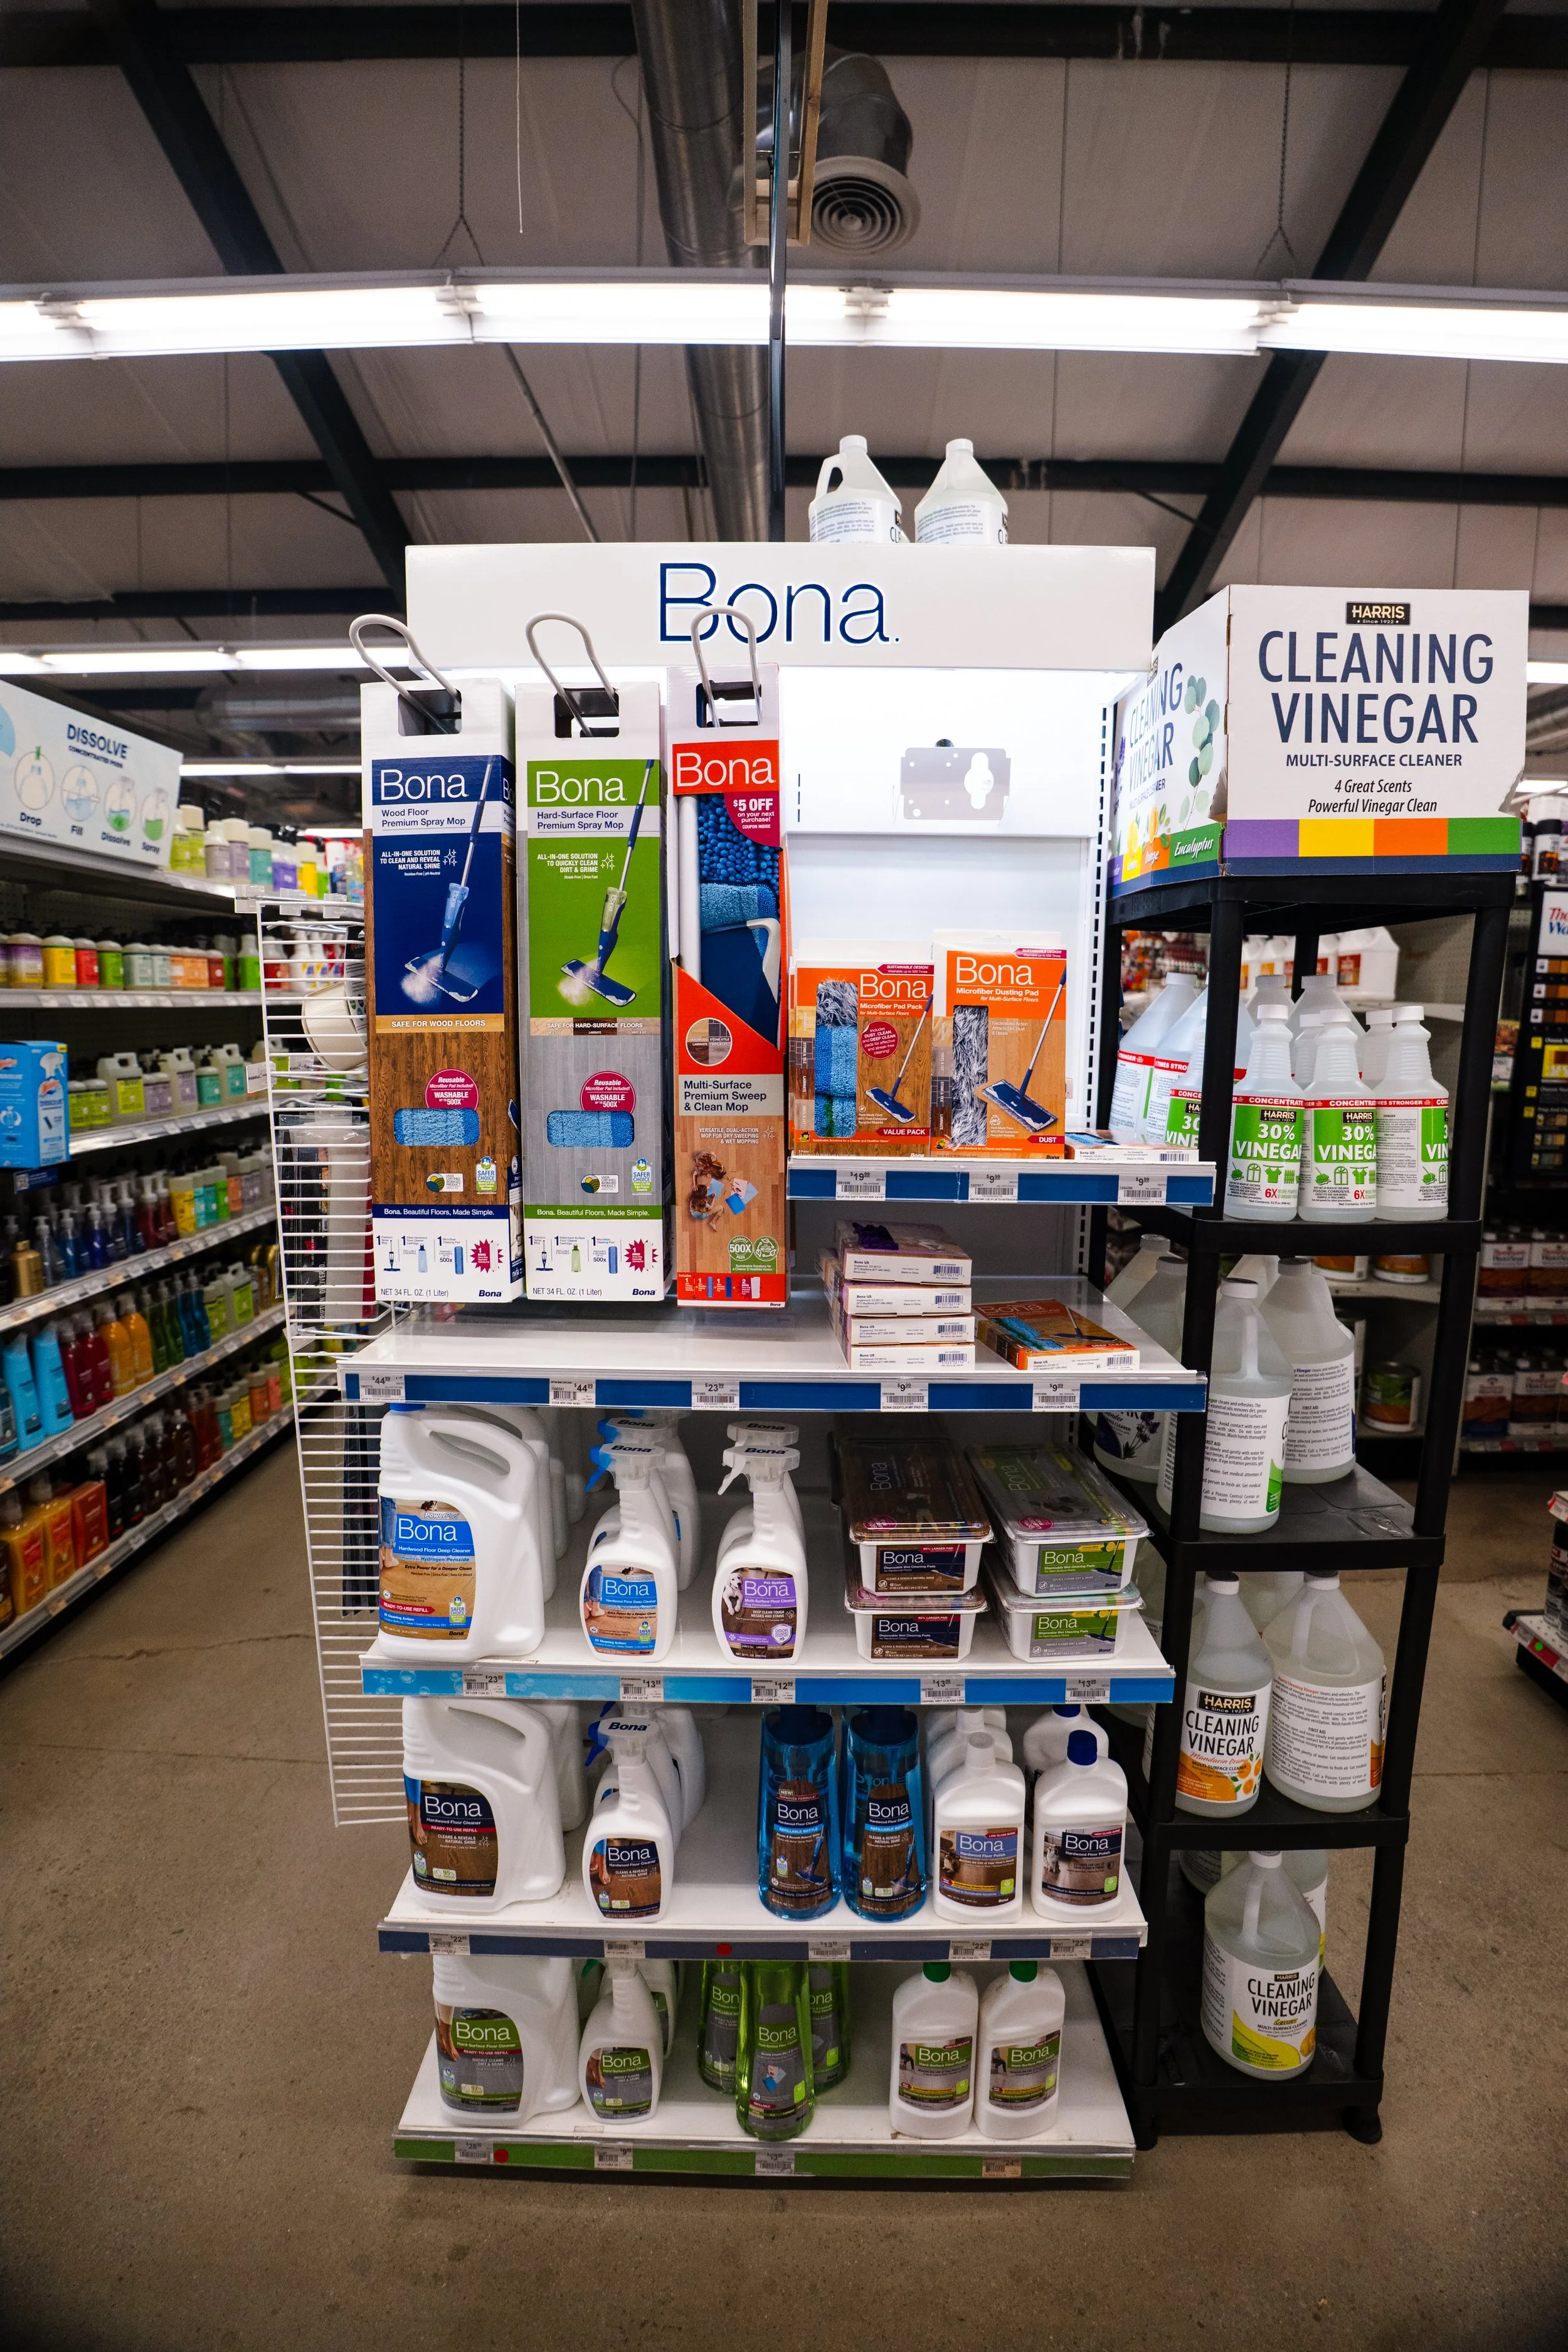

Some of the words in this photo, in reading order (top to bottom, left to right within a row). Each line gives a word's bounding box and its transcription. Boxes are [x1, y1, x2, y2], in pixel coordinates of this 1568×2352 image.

[1352, 606, 1405, 619] HARRIS
[1259, 631, 1493, 684] CLEANING
[1130, 662, 1183, 748] CLEANING
[1271, 692, 1478, 743] VINEGAR
[67, 724, 127, 759] DISSOLVE
[1130, 722, 1173, 793] VINEGAR
[1286, 755, 1396, 767] MULTI-SURFACE
[1399, 755, 1462, 766] CLEANER
[677, 753, 774, 787] Bona
[381, 769, 467, 800] Bona
[536, 771, 625, 802] Bona
[1335, 780, 1341, 793] 4
[1345, 780, 1374, 793] Great
[1377, 780, 1412, 793] Scents
[733, 800, 746, 812] $5
[749, 798, 773, 811] OFF
[1308, 799, 1359, 813] Powerful
[1362, 799, 1404, 815] Vinegar
[1407, 798, 1437, 812] Clean
[20, 812, 41, 826] Drop
[421, 818, 444, 827] Spray
[578, 822, 602, 830] Spray
[605, 822, 623, 830] Mop
[71, 825, 83, 835] Fill
[102, 832, 130, 846] Dissolve
[142, 842, 159, 854] Spray
[1174, 838, 1214, 858] Eucalyptus
[956, 957, 1033, 985] Bona
[860, 974, 928, 999] Bona
[995, 988, 1023, 997] Dusting
[684, 1080, 751, 1089] Multi-Surface
[684, 1091, 729, 1100] Premium
[732, 1091, 766, 1101] Sweep
[1249, 1097, 1303, 1106] CONCENTRATE
[684, 1103, 691, 1111] &
[694, 1103, 723, 1111] Clean
[726, 1103, 748, 1112] Mop
[1264, 1111, 1295, 1120] HARRIS
[1258, 1124, 1295, 1141] 30%
[1342, 1126, 1374, 1141] 30%
[1265, 1189, 1278, 1199] 6X
[729, 1244, 751, 1253] 500X
[426, 1290, 431, 1298] (1
[611, 1444, 653, 1453] Bona
[398, 1518, 457, 1542] Bona
[884, 1552, 923, 1564] Bona
[1045, 1552, 1084, 1564] Bona
[606, 1580, 649, 1596] Bona
[744, 1581, 788, 1597] Bona
[1204, 1695, 1253, 1709] HARRIS
[608, 1722, 647, 1731] Bona
[1185, 1710, 1259, 1736] CLEANING
[1189, 1731, 1254, 1756] VINEGAR
[425, 1796, 482, 1818] Bona
[869, 1801, 909, 1819] Bona
[960, 1836, 1003, 1851] Bona
[608, 1847, 650, 1862] Bona
[1248, 1971, 1315, 1999] CLEANING
[1252, 1993, 1312, 2017] VINEGAR
[456, 2021, 510, 2041] Bona
[919, 2047, 960, 2063] Bona
